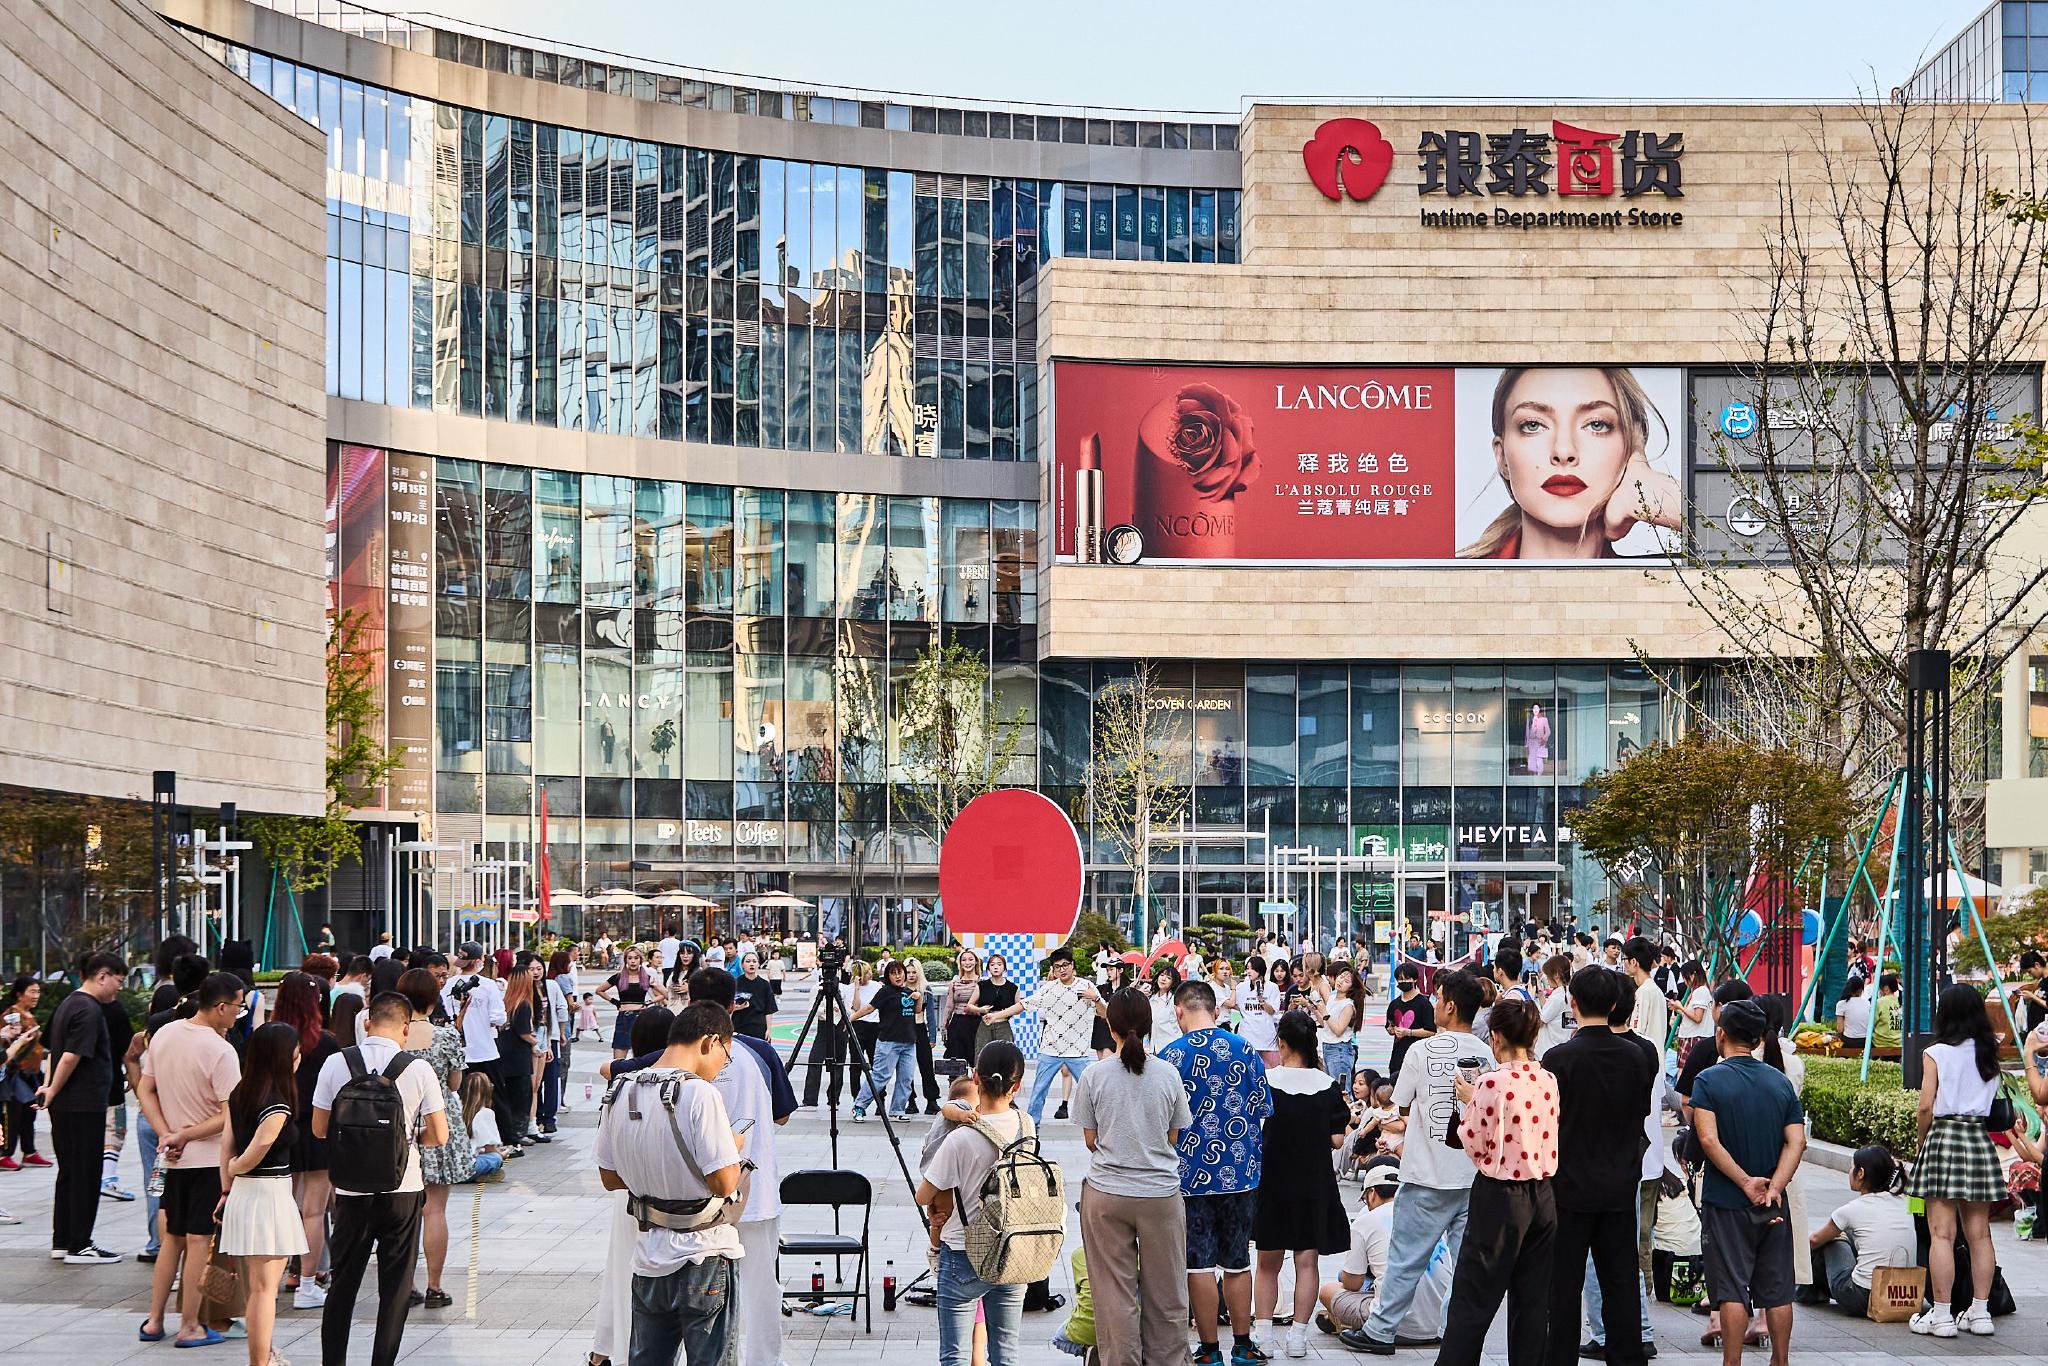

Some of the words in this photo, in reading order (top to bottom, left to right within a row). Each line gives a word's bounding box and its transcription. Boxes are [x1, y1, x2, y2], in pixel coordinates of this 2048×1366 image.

[1418, 119, 1685, 198] 银泰百货
[1421, 207, 1488, 226] Intime
[1494, 207, 1622, 230] Department
[1628, 207, 1683, 226] Store
[1275, 380, 1433, 410] LANCÔME
[1297, 452, 1409, 474] 释我绝色
[391, 481, 428, 496] 9月15日
[1275, 484, 1361, 496] L'ABSOLU
[1371, 484, 1433, 496] ROUGE
[391, 510, 428, 525] 10月2日
[735, 820, 778, 846] Coffee
[1459, 826, 1548, 844] HEYTEA
[1887, 1285, 1918, 1299] MUJI
